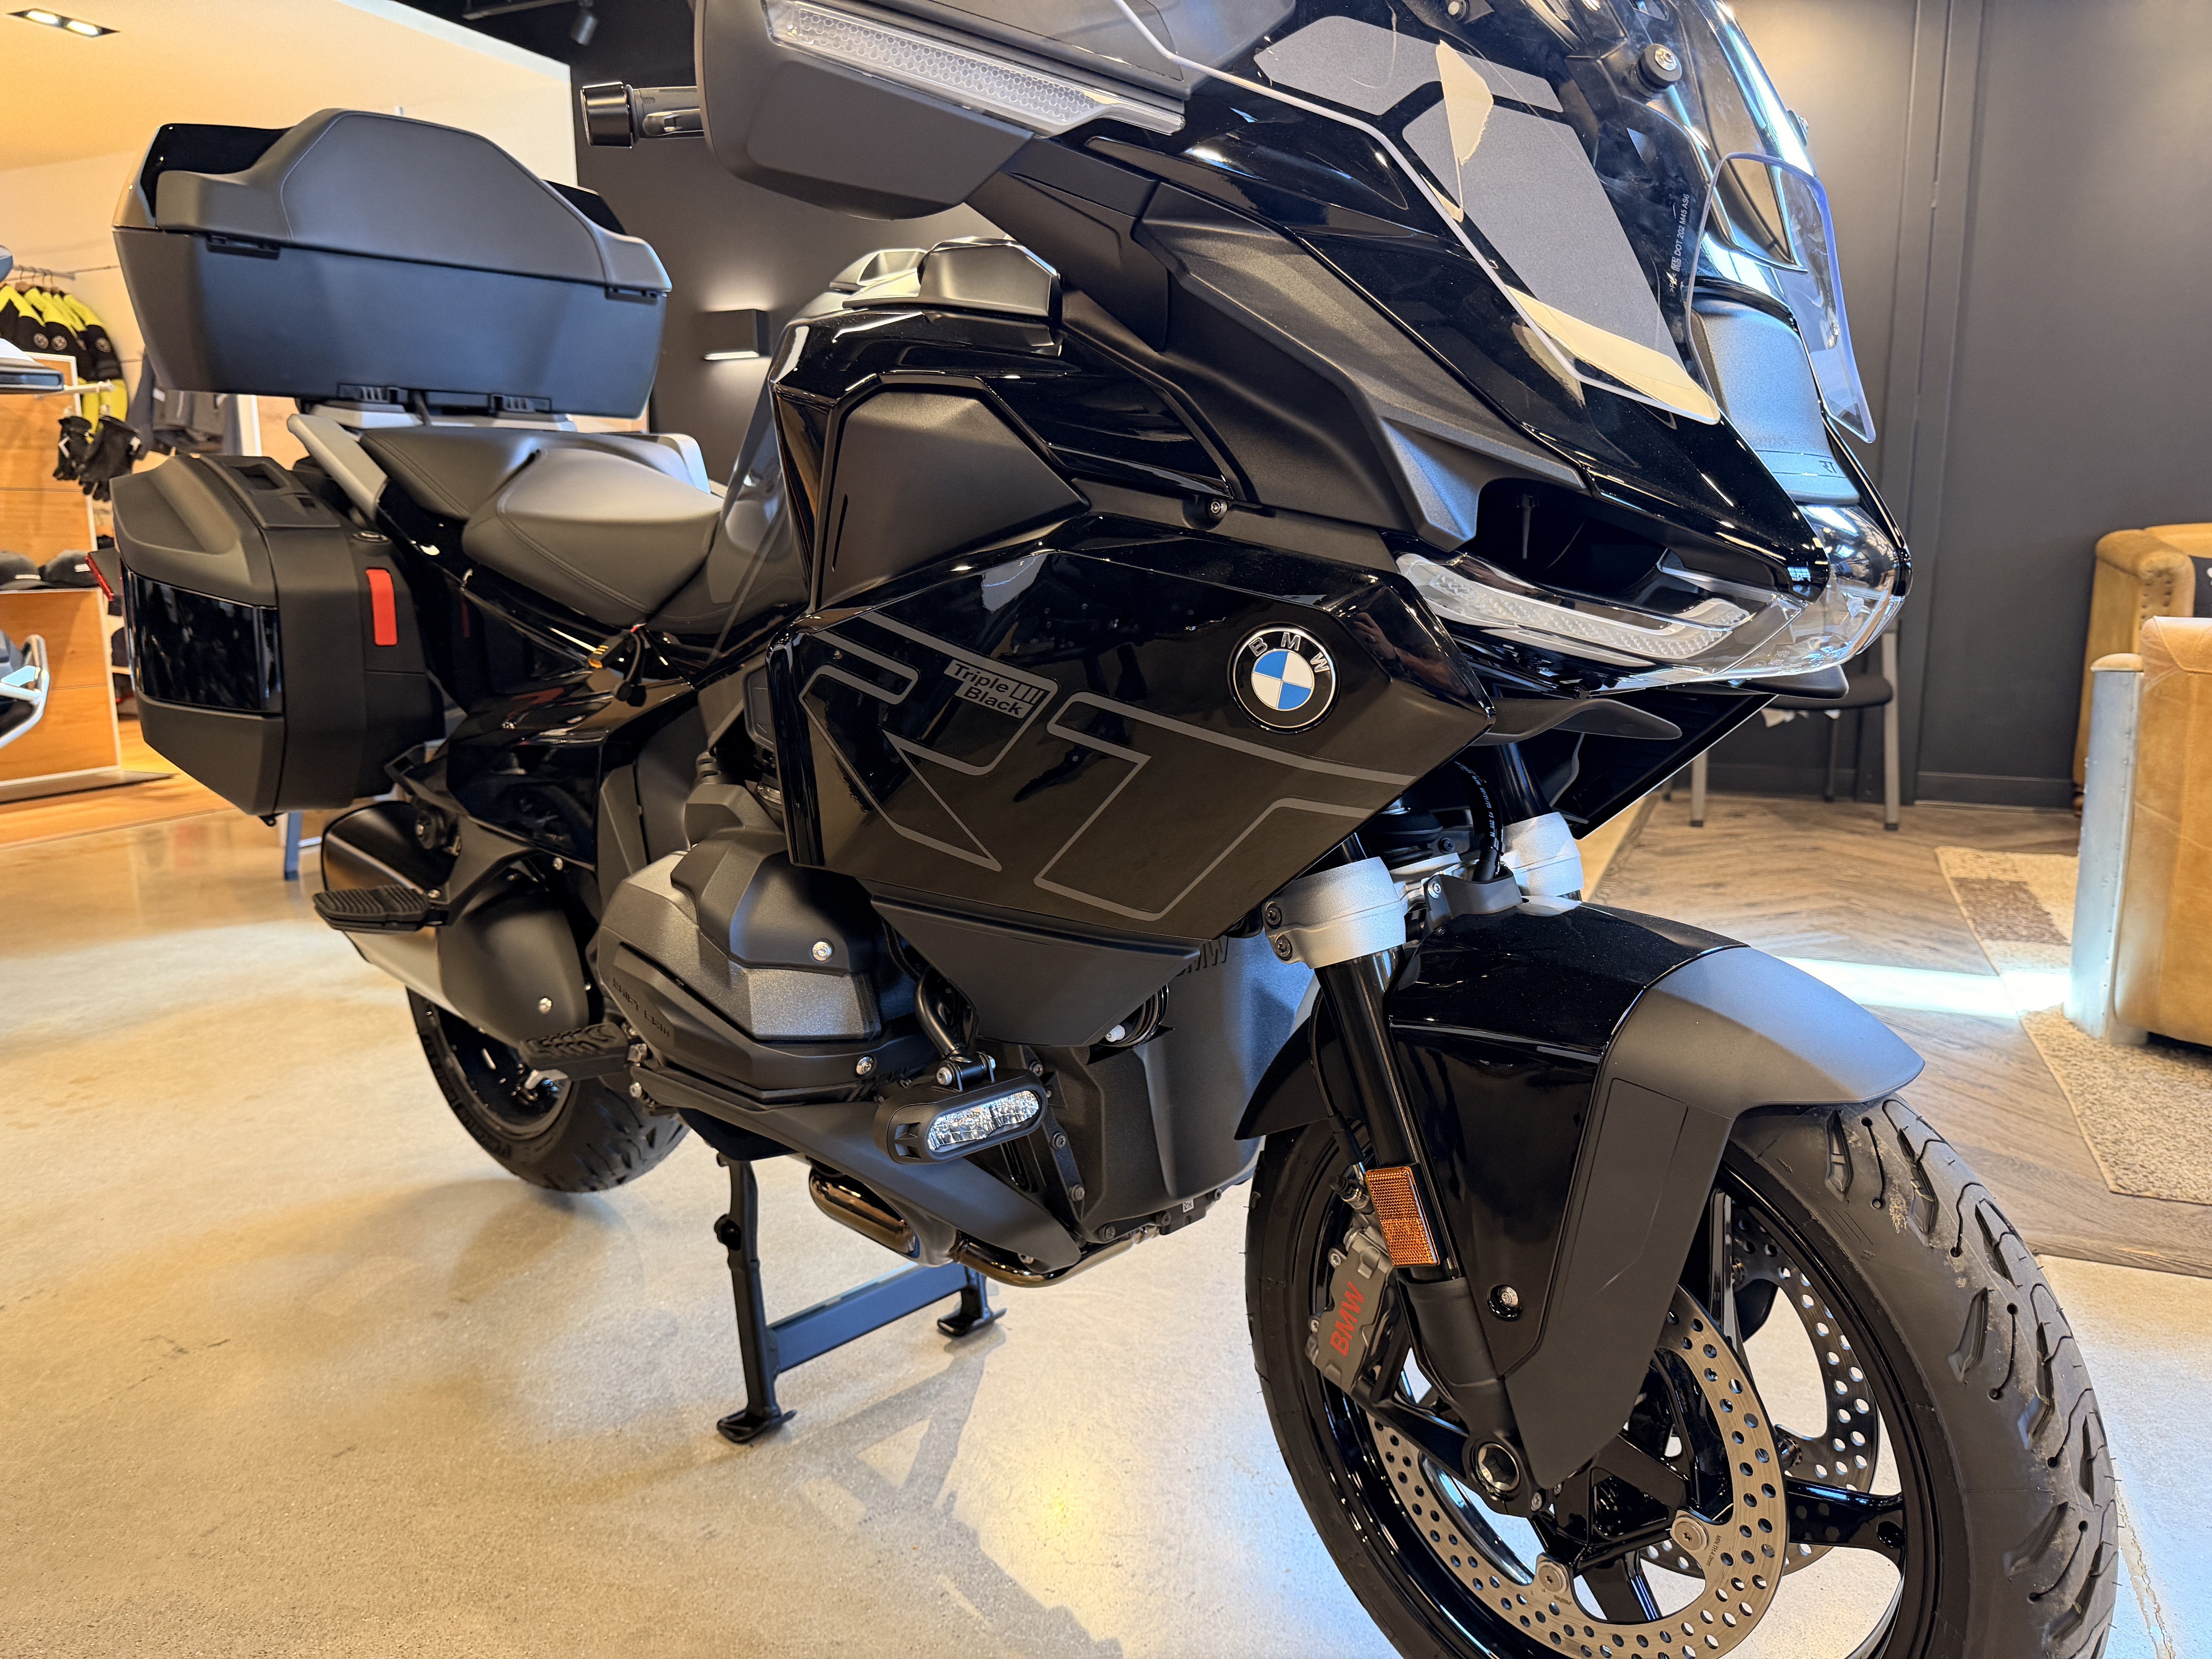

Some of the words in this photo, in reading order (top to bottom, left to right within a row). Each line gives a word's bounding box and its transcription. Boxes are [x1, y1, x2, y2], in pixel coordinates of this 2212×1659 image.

[1674, 239, 1683, 256] DOT
[1248, 632, 1330, 673] BMW
[954, 663, 1009, 693] Triple
[963, 686, 1024, 716] Black
[1187, 936, 1229, 974] MW
[1329, 1280, 1365, 1357] BMW
